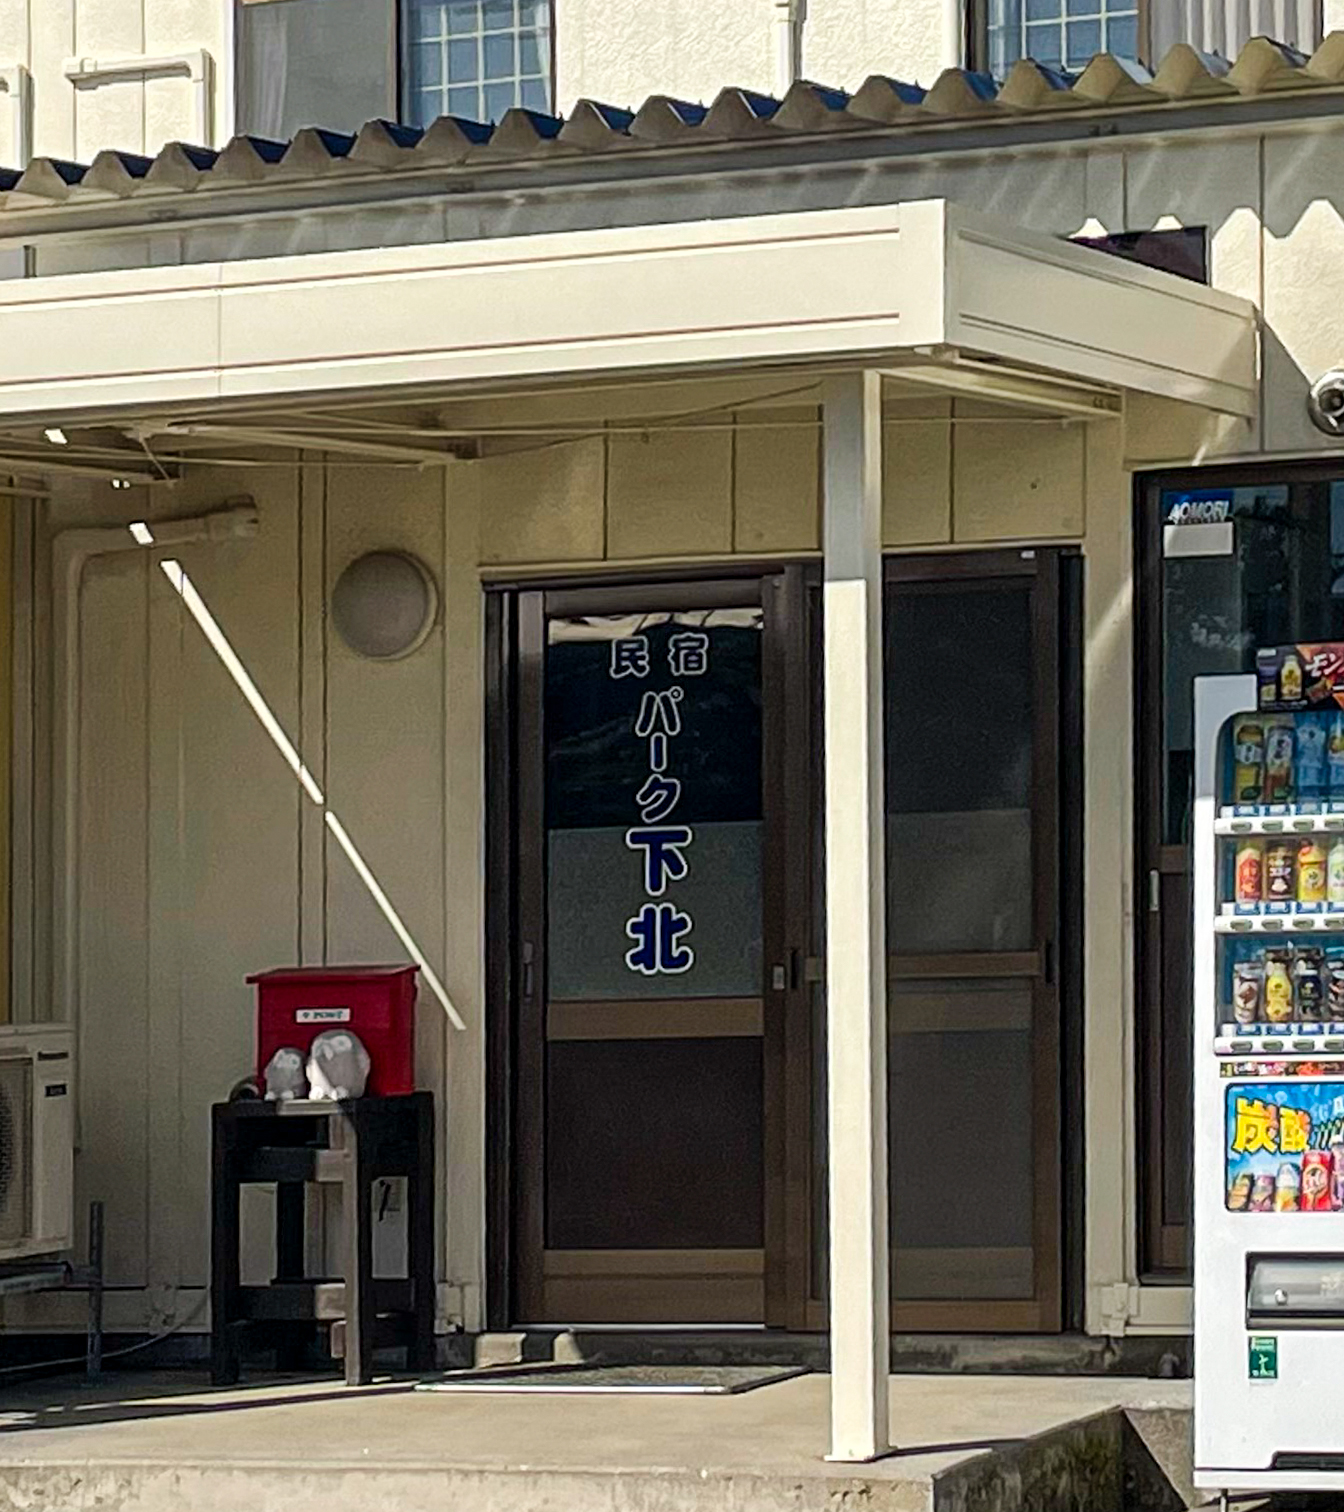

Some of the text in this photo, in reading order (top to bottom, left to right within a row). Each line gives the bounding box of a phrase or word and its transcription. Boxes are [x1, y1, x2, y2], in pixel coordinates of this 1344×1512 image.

[609, 633, 709, 678] 民宿
[626, 686, 694, 974] パーク下北
